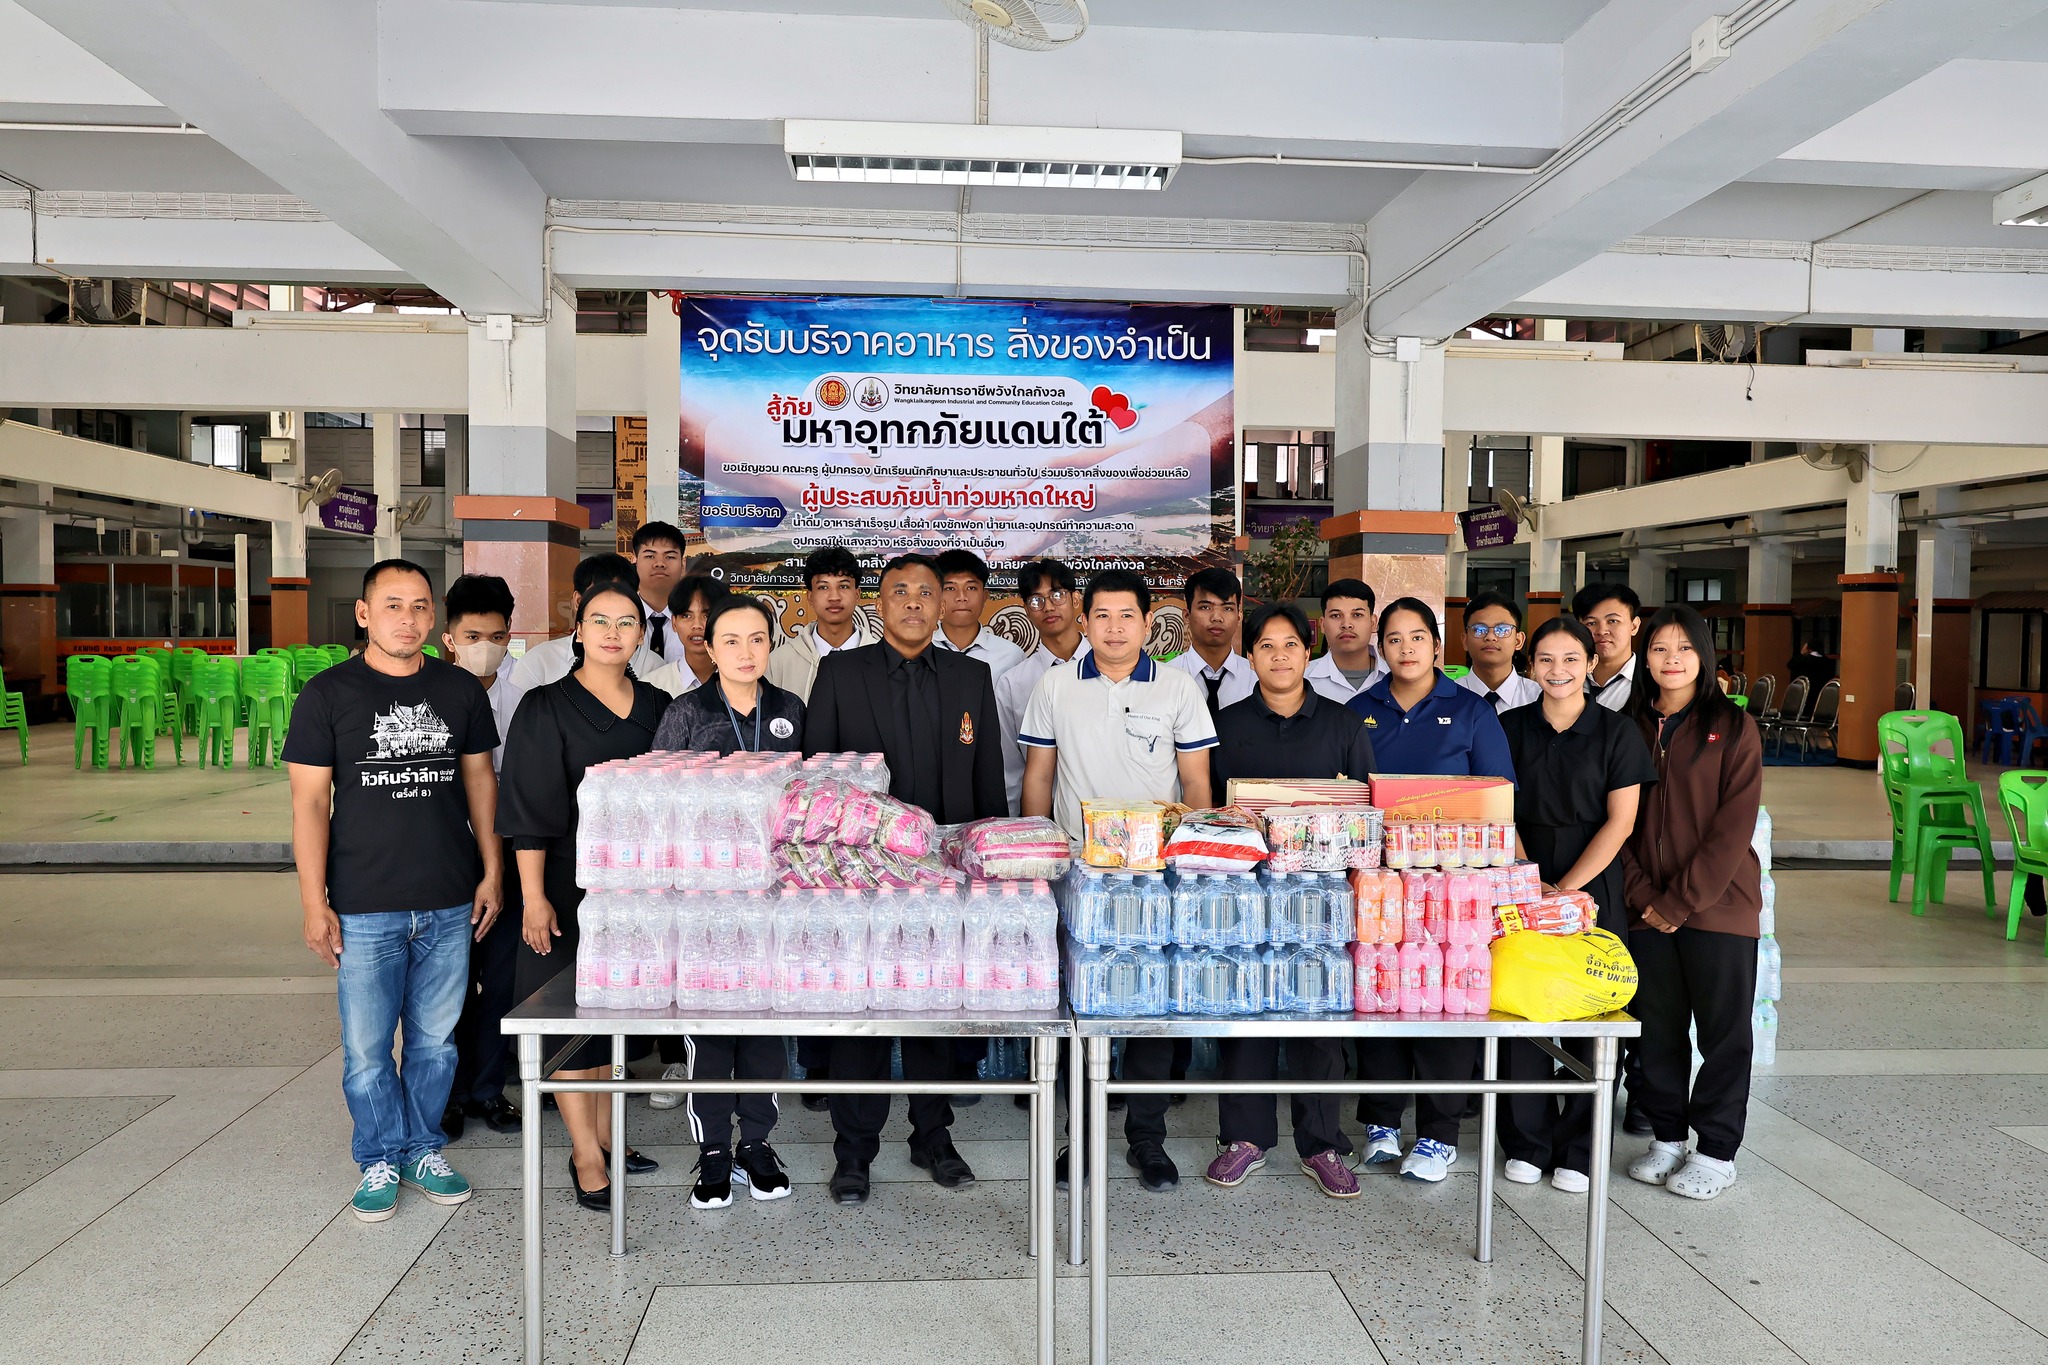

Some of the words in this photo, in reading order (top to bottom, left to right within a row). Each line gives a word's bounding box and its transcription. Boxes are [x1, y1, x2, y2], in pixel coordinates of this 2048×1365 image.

[697, 321, 994, 361] จุดรับบริจาคอาหาร
[1007, 317, 1211, 360] สิ่งของจำเป็น
[894, 384, 1065, 398] วิทยาลัยการอาชีพวังไกลกังวล
[767, 394, 812, 422] สู้ภัย
[783, 410, 1103, 454] มหาอุทกภัยแดนใต้
[723, 463, 779, 474] ขอเชิญชวน
[782, 466, 819, 477] คณะครู
[822, 465, 870, 477] ผู้ปกครอง
[873, 465, 1037, 477] นักเรียนนักศึกษาและประชาชนทั่วไป
[1041, 466, 1189, 479] ร่วมบริจาคสิ่งของเพื่อช่วยเหลือ
[802, 479, 1094, 512] ผู้ประสบภัยน้ำท่วมหาดใหญ่
[702, 505, 780, 518] ขอรับบริจาค
[793, 514, 820, 527] น้ำดื่ม
[823, 517, 896, 531] อาหารสำเร็จรูป
[900, 516, 930, 529] เสื้อผ้า
[933, 520, 983, 530] ผงซักฟอก
[987, 516, 1134, 533] น้ำยาและอุปกรณ์ทำความสะอาด
[793, 535, 890, 548] อุปกรณ์ให้แสงสว่าง
[893, 535, 1004, 549] หรือสิ่งของที่จำเป็นอื่นๆ
[361, 767, 439, 787] หัวหินรำลึก
[1586, 968, 1604, 978] GEE
[1607, 973, 1620, 982] UN
